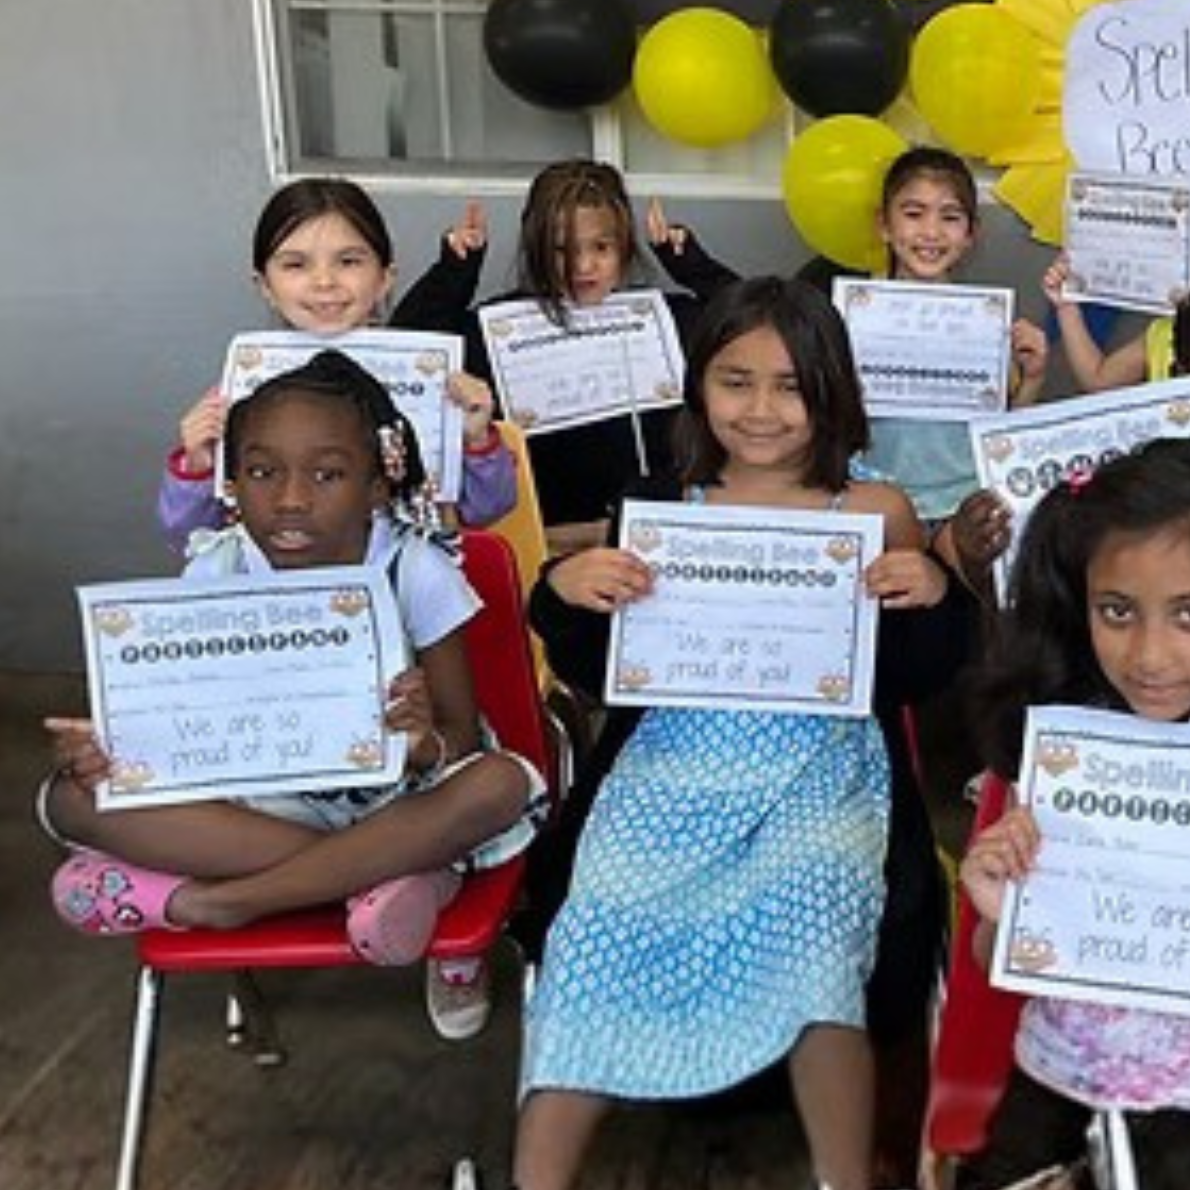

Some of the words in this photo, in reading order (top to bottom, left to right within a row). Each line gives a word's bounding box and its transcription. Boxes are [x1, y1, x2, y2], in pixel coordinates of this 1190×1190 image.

[667, 536, 765, 564] Spelling
[771, 540, 820, 563] Bee
[141, 608, 260, 640] Spelling
[266, 603, 323, 625] Bee
[173, 714, 214, 739] We
[226, 714, 266, 733] are
[171, 745, 230, 777] proud
[1091, 889, 1136, 924] We
[1078, 935, 1148, 966] proud
